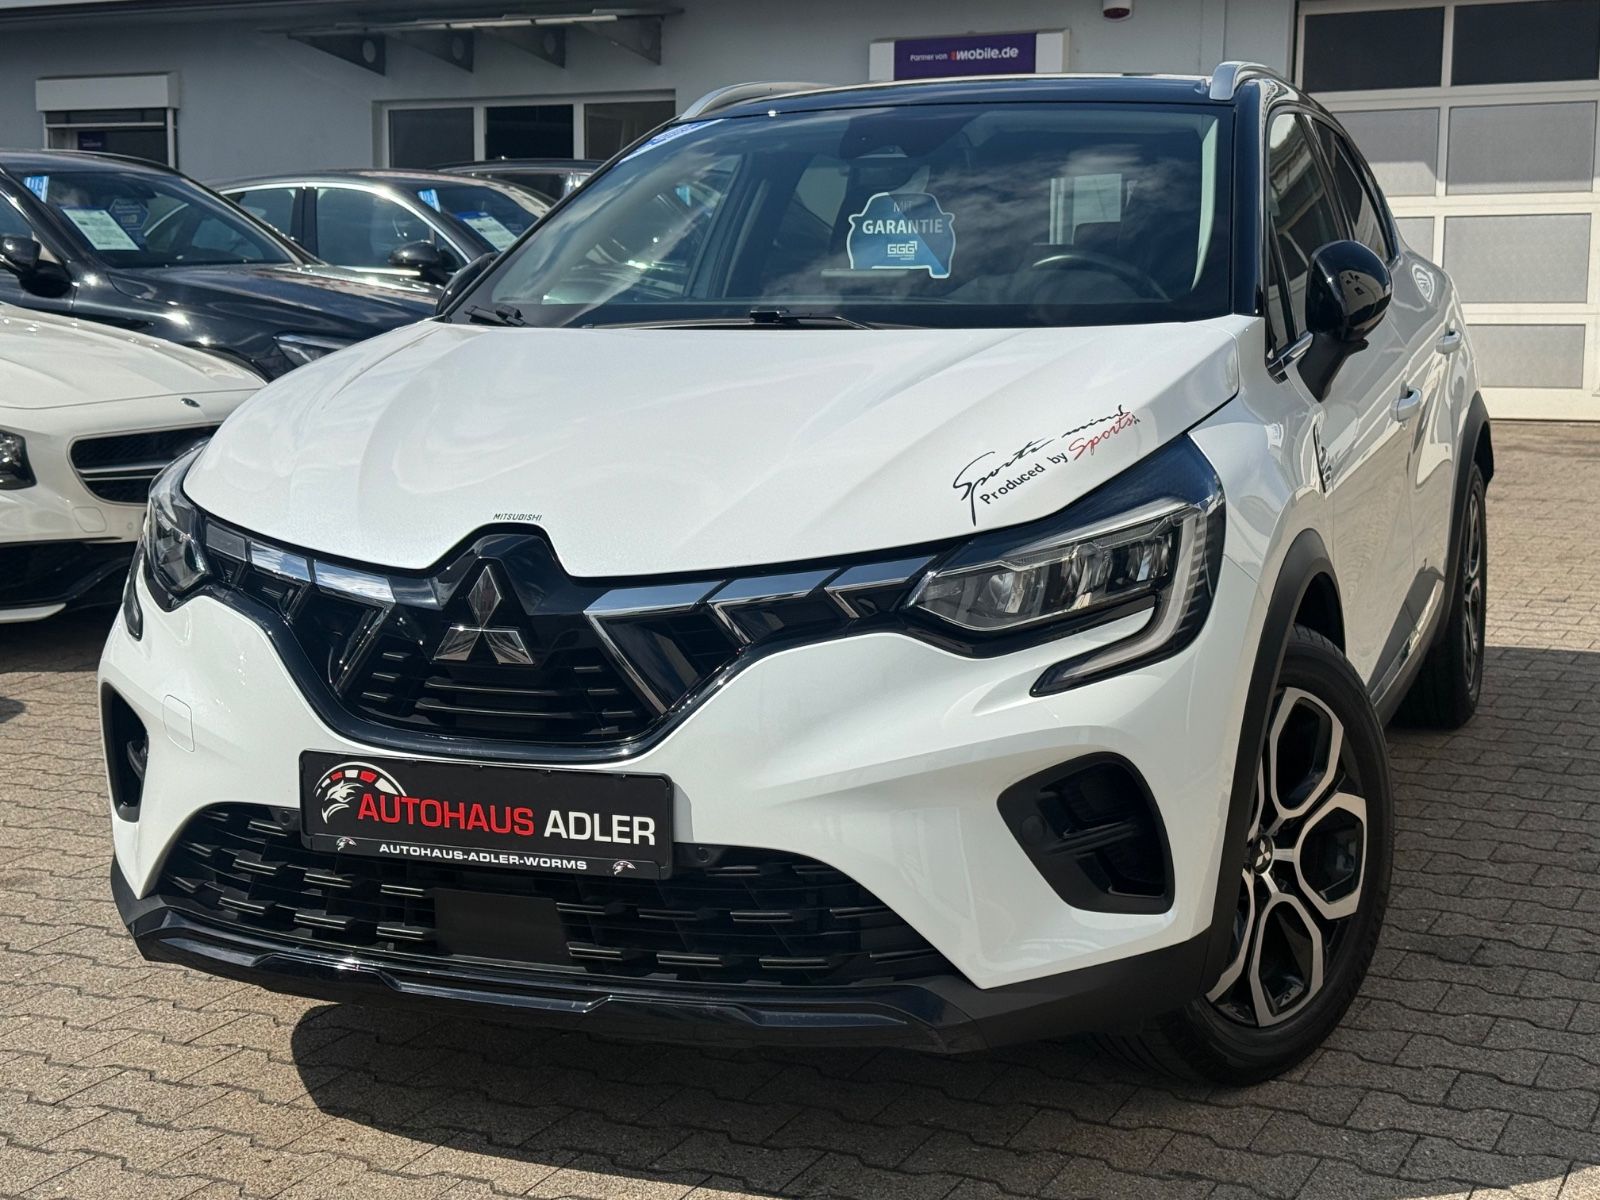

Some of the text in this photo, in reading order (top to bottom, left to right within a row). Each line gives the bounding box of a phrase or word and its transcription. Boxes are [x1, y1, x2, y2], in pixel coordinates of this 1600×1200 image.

[956, 47, 1019, 60] mobile.de
[893, 201, 912, 213] MIT
[862, 219, 943, 234] GARANTIE
[887, 243, 916, 254] GGG
[979, 411, 1134, 504] Produced by Sports
[357, 792, 656, 845] AUTOHAUS ADLER
[379, 843, 587, 870] AUTOHAUS-ADLER-WORMS
